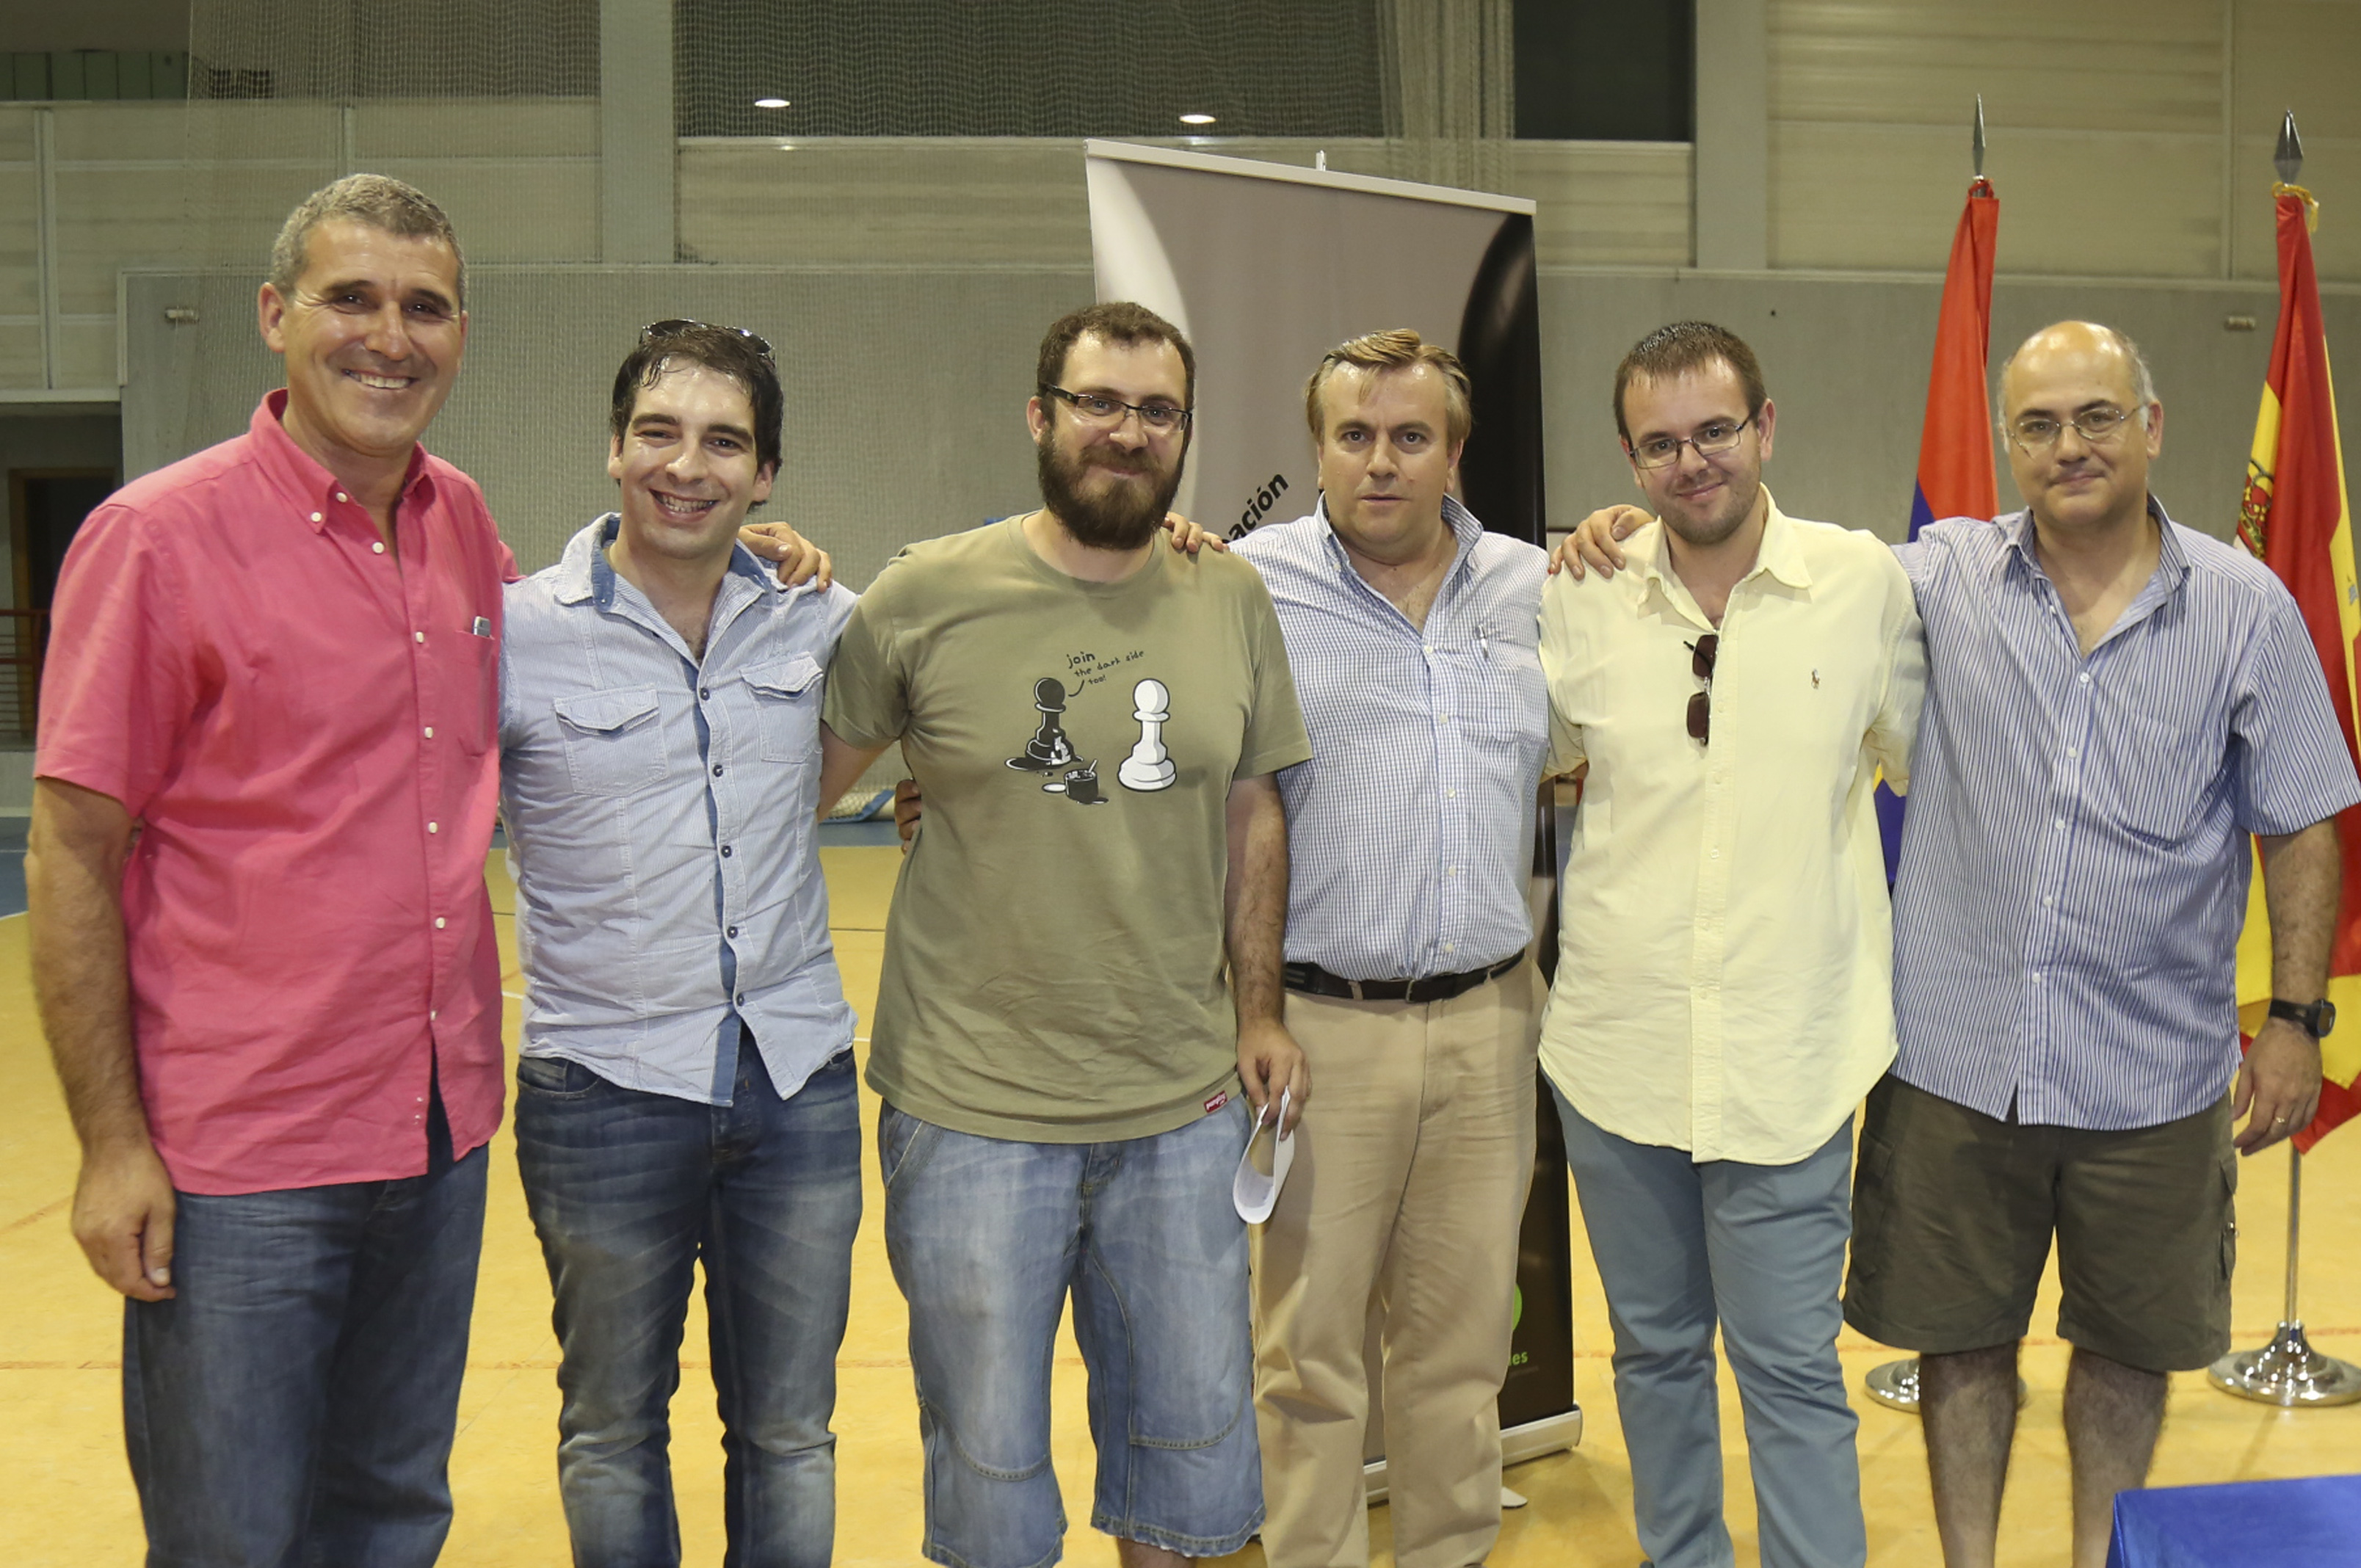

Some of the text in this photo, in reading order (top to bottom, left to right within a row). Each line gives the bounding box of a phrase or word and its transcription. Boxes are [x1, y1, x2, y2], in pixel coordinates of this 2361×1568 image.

[1222, 473, 1289, 544] ación
[1067, 651, 1095, 669] join
[1074, 650, 1144, 677] the dark side
[1509, 1351, 1528, 1366] es
